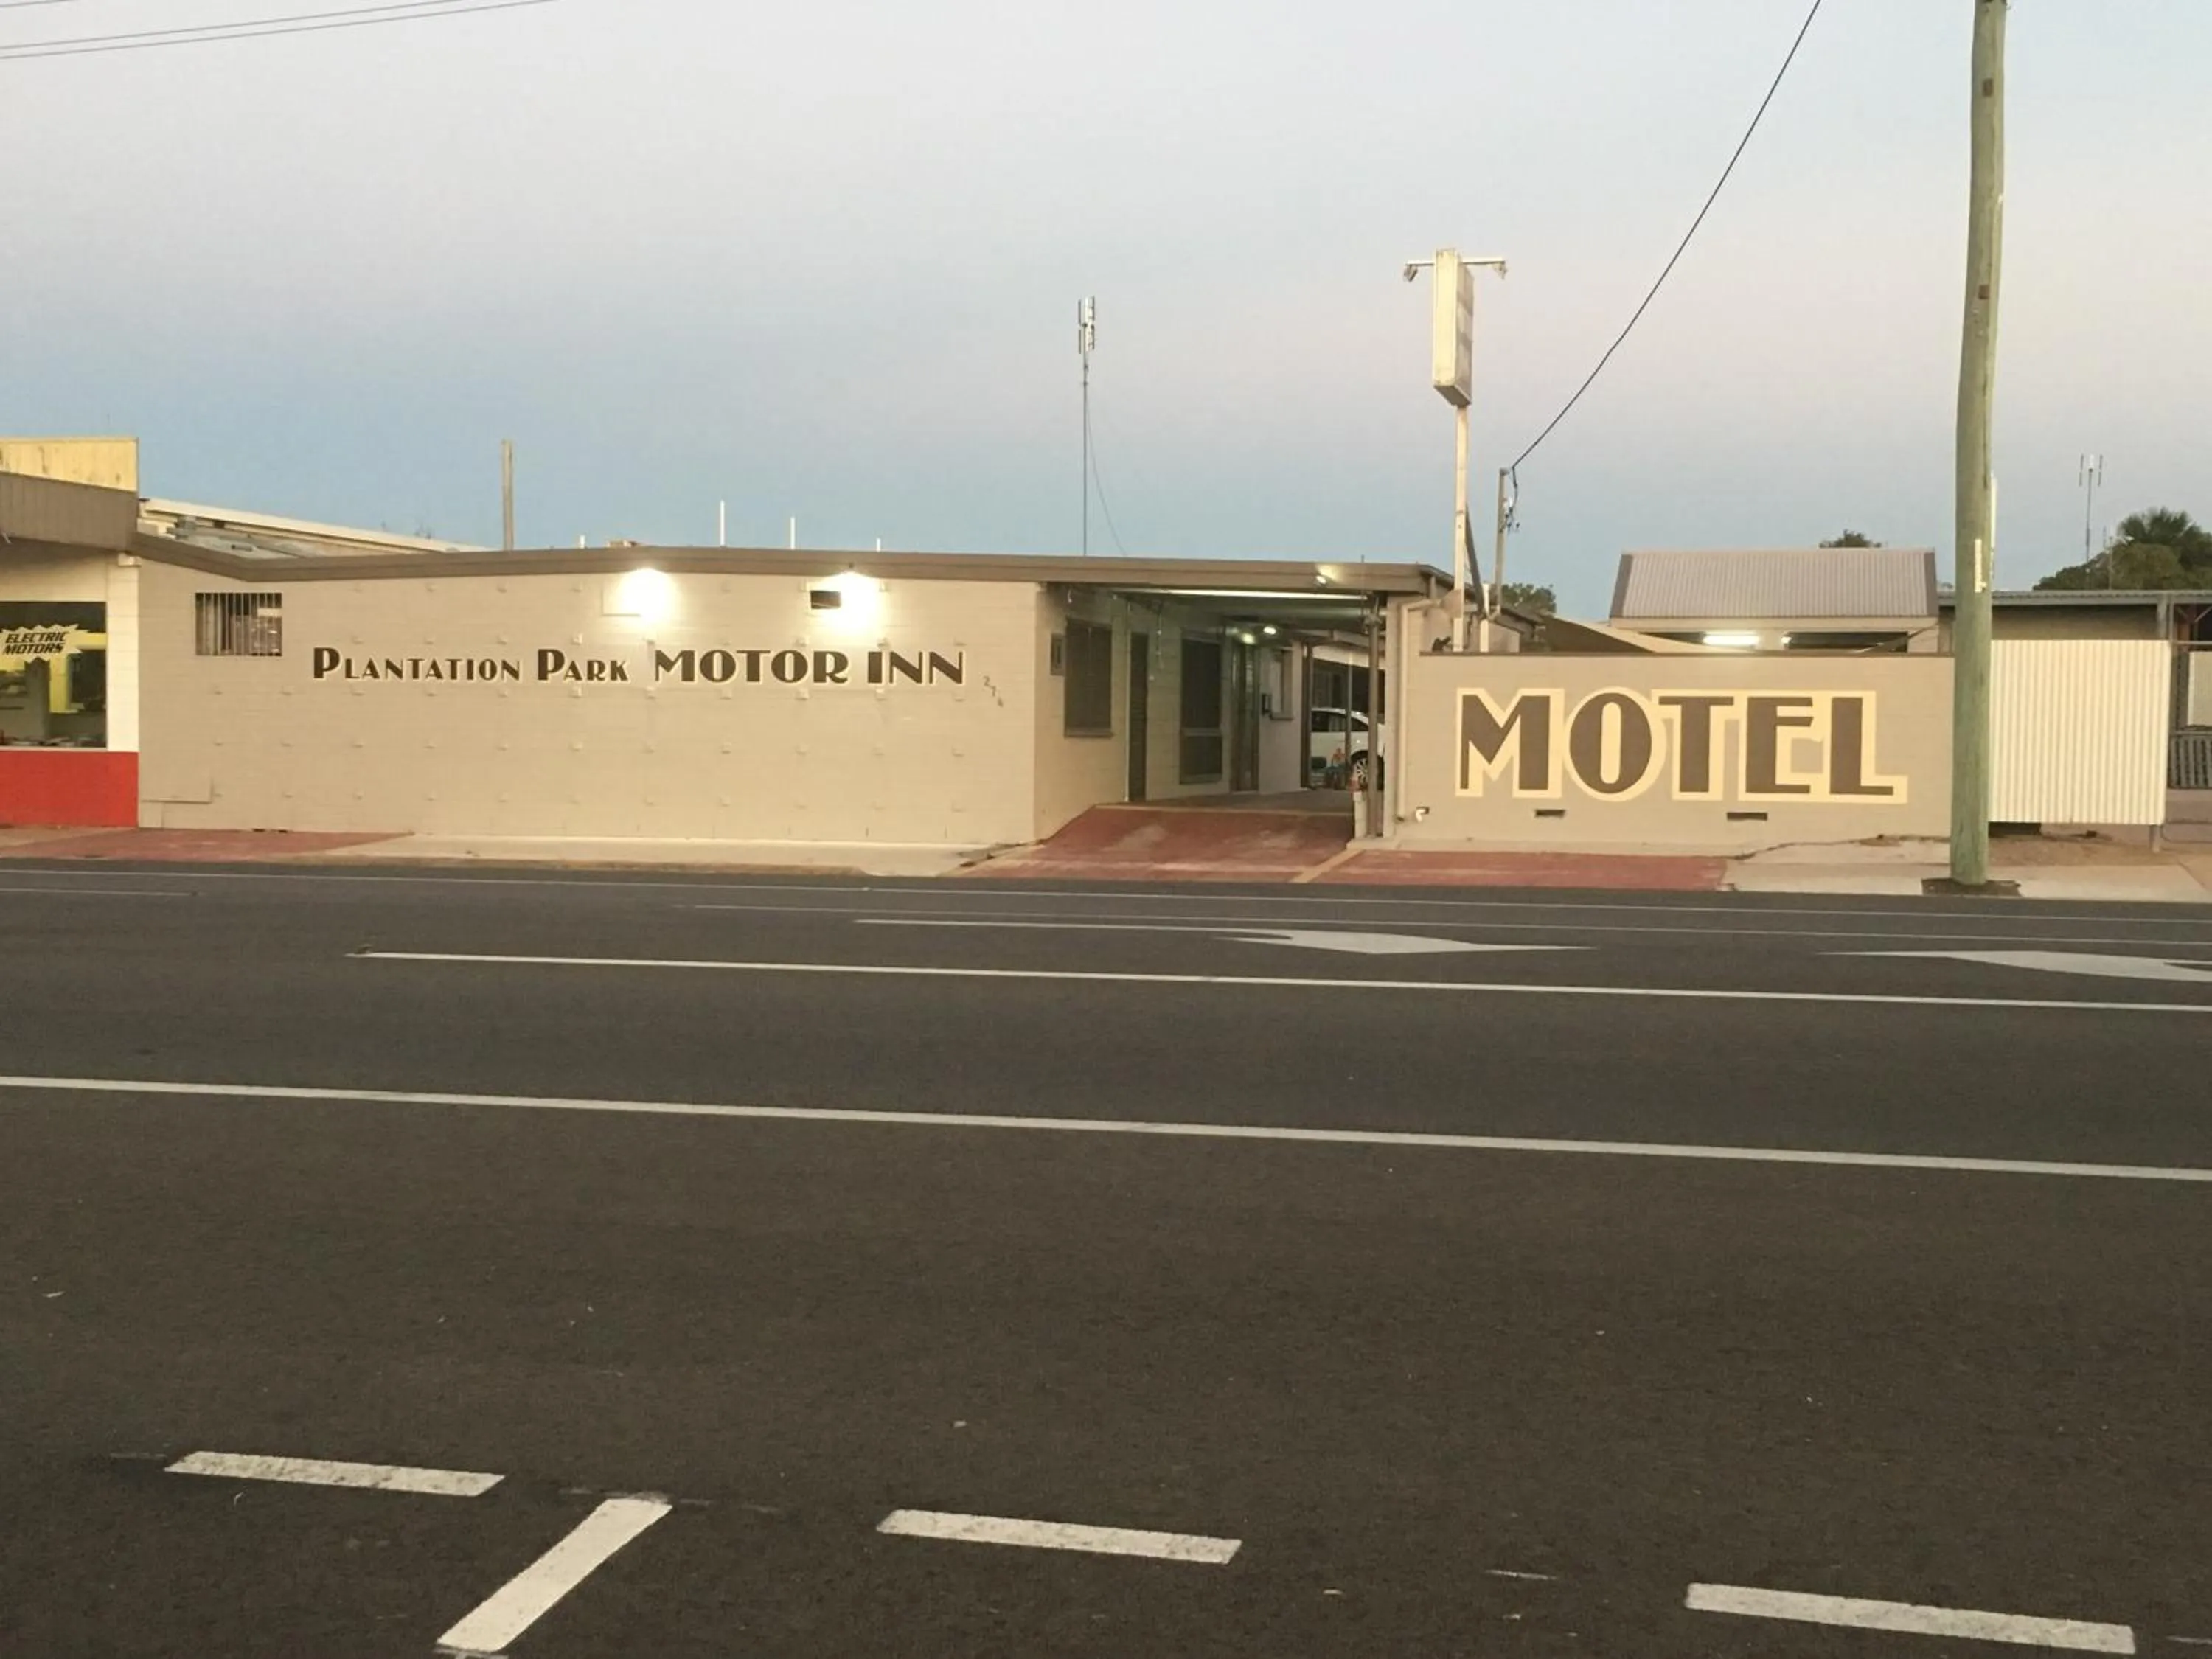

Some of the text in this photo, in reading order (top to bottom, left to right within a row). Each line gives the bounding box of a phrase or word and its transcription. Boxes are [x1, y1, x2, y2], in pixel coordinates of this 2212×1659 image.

[3, 644, 65, 655] MOTORS
[5, 632, 66, 644] ELECTRIC
[313, 647, 963, 684] PLANTATION PARK MOTOR INN
[1457, 688, 1904, 801] MOTEL
